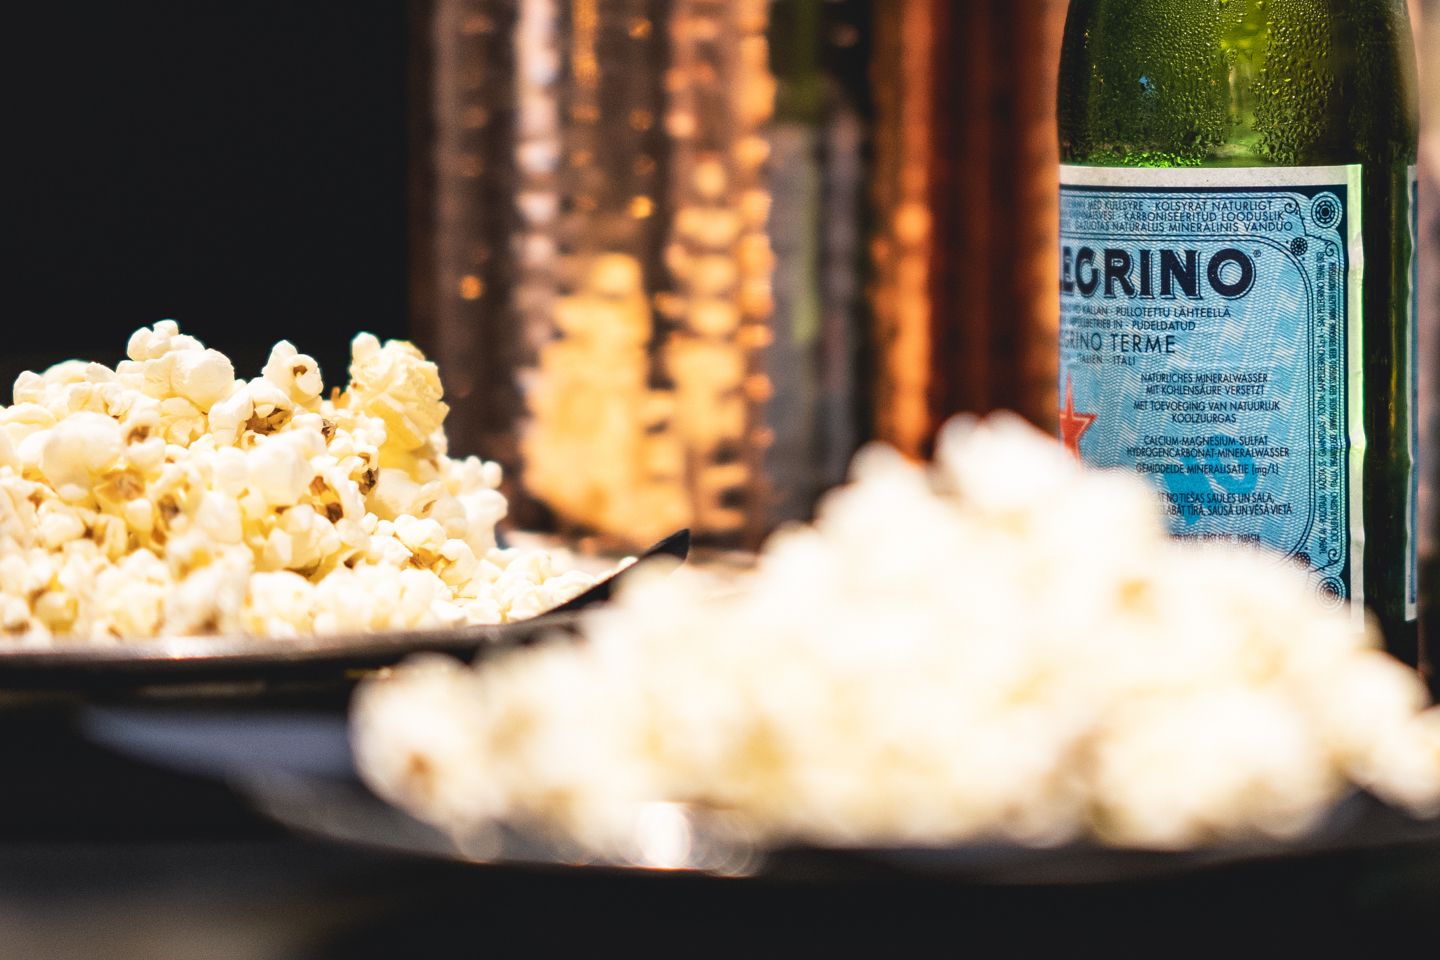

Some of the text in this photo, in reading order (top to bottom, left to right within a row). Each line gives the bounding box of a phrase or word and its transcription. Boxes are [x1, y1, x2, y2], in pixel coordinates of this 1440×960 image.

[1155, 201, 1207, 211] KOLSYRAT
[1212, 201, 1273, 211] NATURLIGT
[1125, 211, 1217, 221] KARBONISEERITUD
[1222, 211, 1284, 222] LOODUSLIK
[1113, 222, 1165, 232] NATURALUS
[1169, 222, 1239, 232] MINERALINIS
[1244, 221, 1293, 231] VANDUO
[1116, 306, 1170, 317] PULLOTETTU
[1174, 305, 1231, 318] LÄHTEELLÄ
[1132, 321, 1196, 331] PUDELDATUD
[1111, 334, 1176, 353] TERME
[1141, 371, 1268, 383] NATÜRLICHES MINERALWASSER
[1146, 383, 1264, 395] MIT KOHLENSÄURE VERSETZT
[1133, 400, 1280, 411] MET TOEVOEGING VAN NATUURLIJK
[1171, 413, 1236, 423] KOOLZUURGAS
[1136, 463, 1184, 475] GEMIDDELDE
[1187, 463, 1249, 475] MINERALISATIE
[1207, 493, 1236, 503] SAULES
[1238, 493, 1249, 503] UN
[1235, 505, 1247, 515] UN
